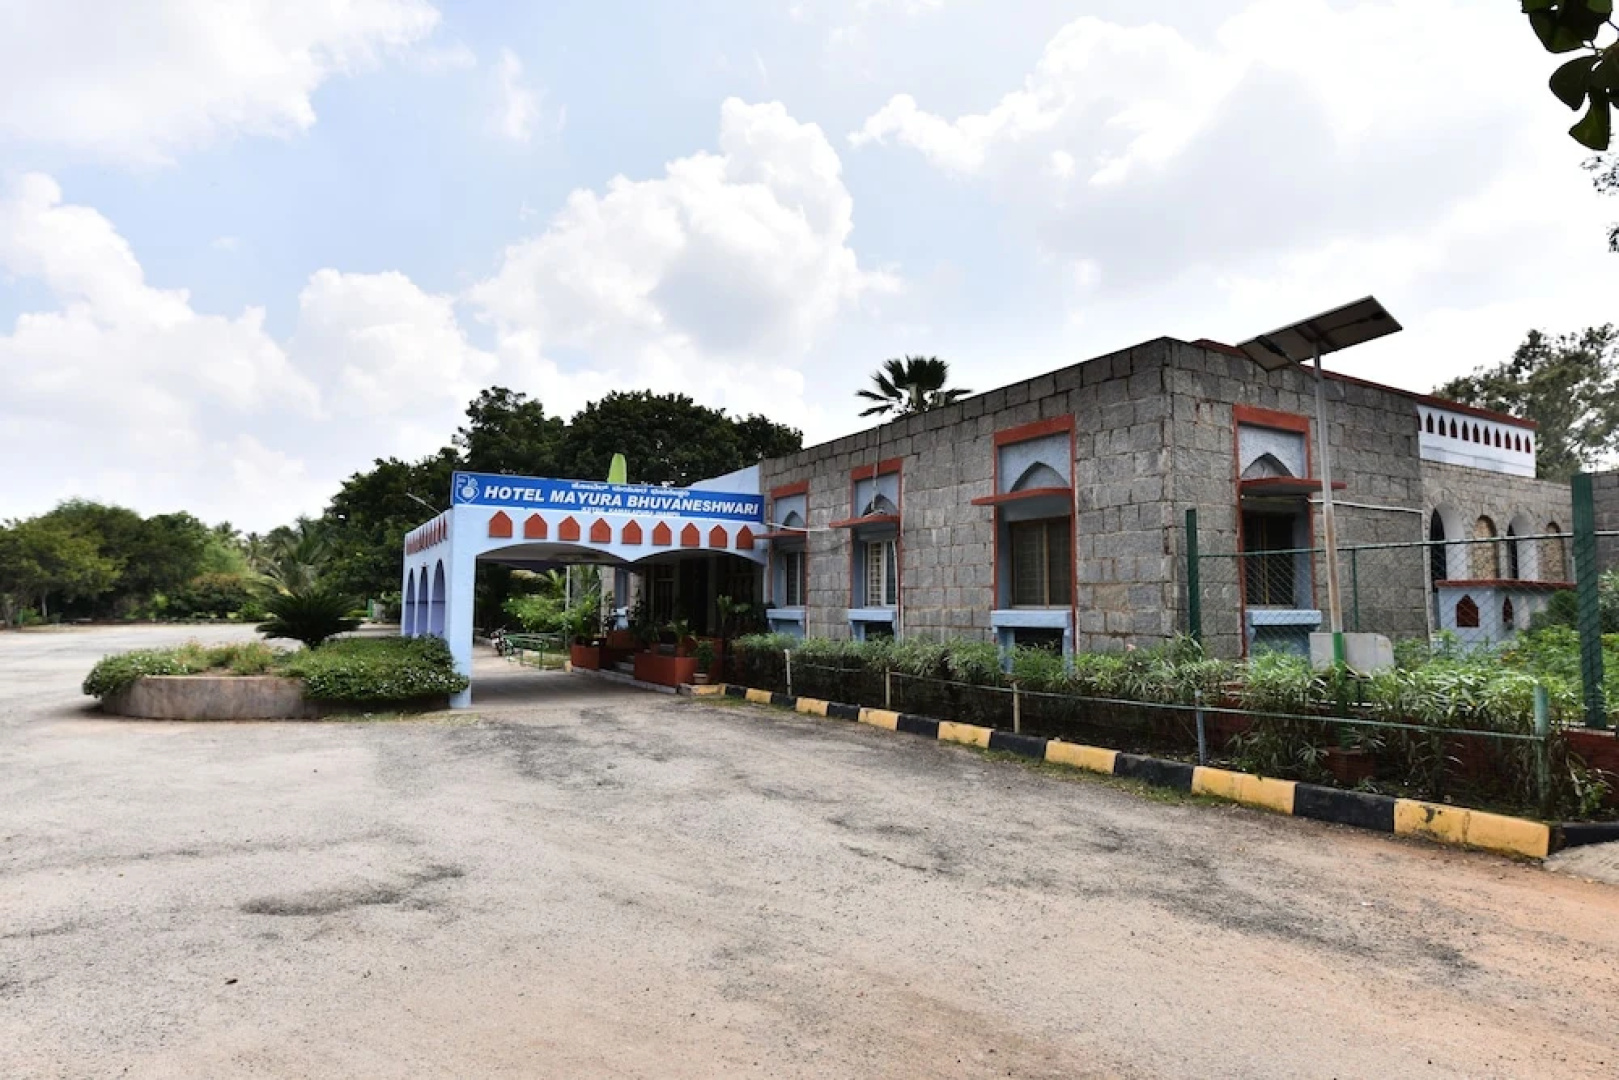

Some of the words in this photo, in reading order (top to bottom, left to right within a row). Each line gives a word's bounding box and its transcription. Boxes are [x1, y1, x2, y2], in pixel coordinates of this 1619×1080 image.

[483, 485, 545, 503] HOTEL
[550, 489, 622, 506] MAYURA
[627, 495, 759, 515] BHUVANESHWARI
